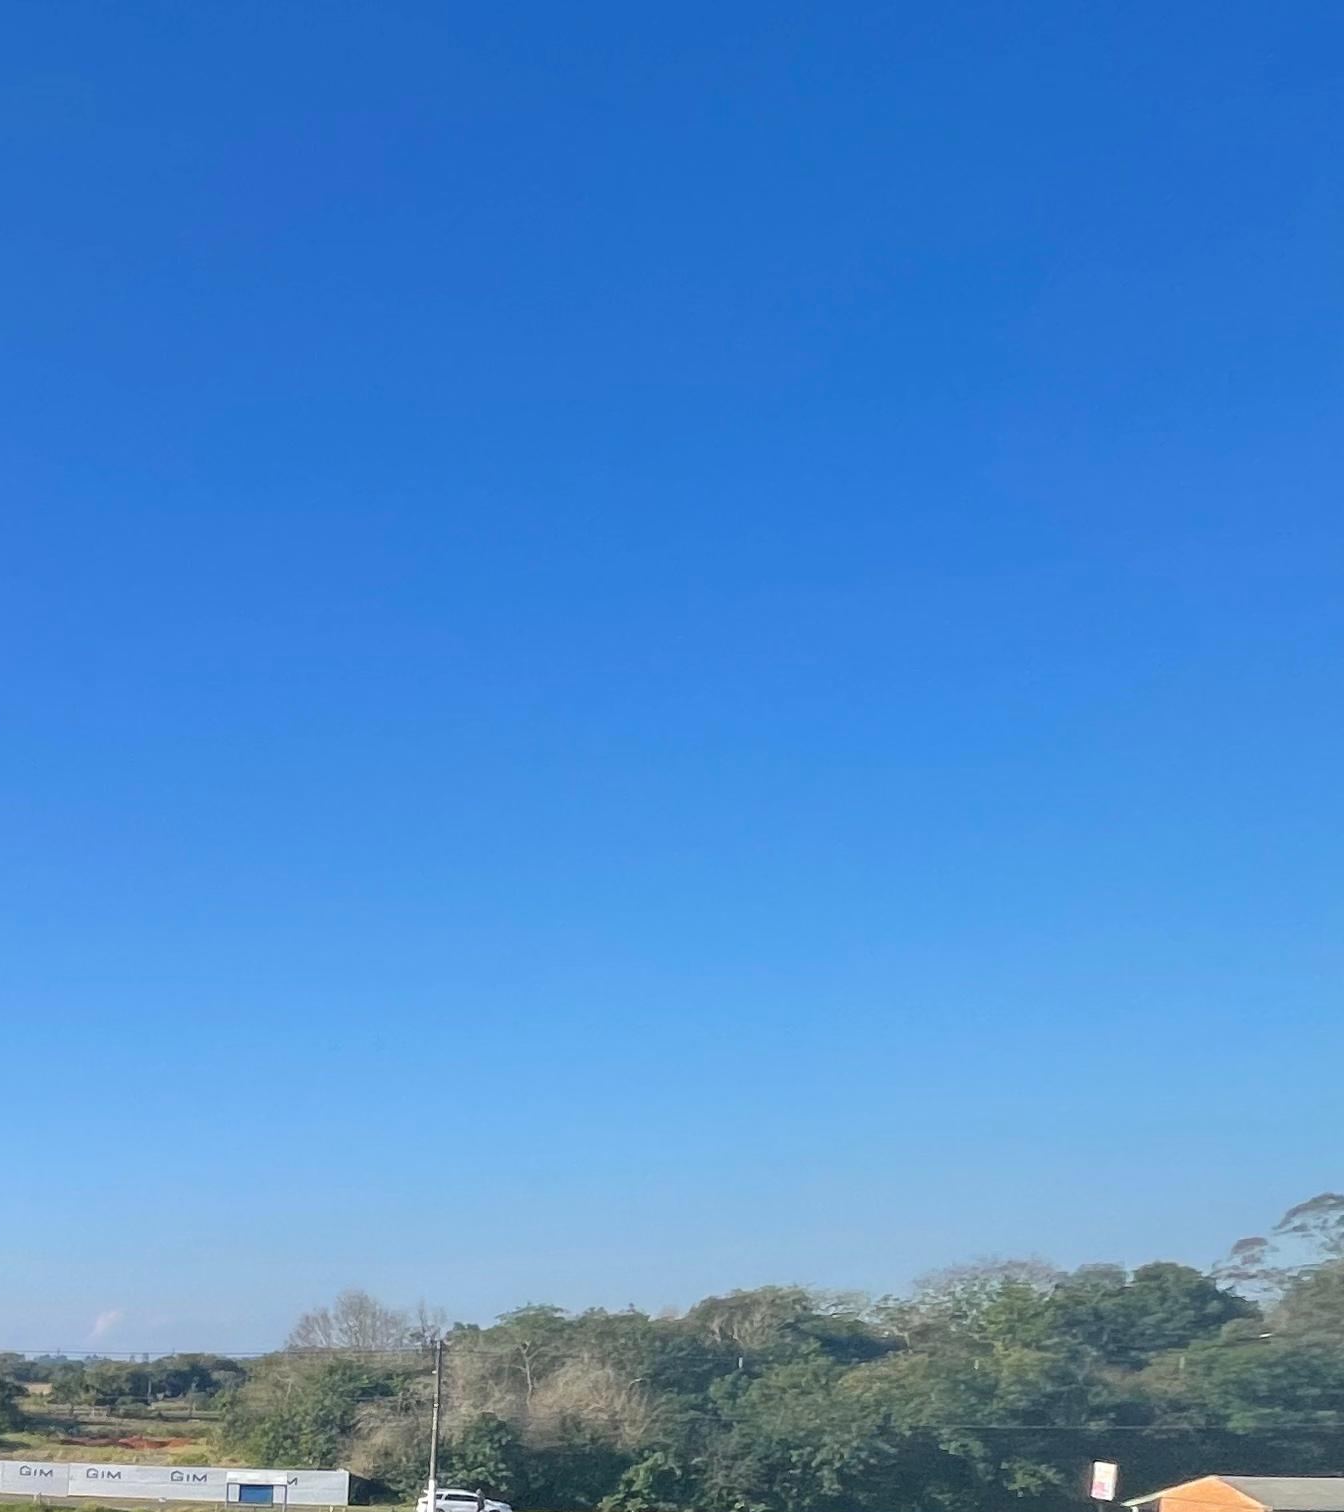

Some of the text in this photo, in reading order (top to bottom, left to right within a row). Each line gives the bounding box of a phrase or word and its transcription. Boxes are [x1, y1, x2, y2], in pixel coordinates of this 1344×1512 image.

[19, 1465, 53, 1477] GIM
[86, 1468, 121, 1479] GIM
[170, 1470, 207, 1483] GIM
